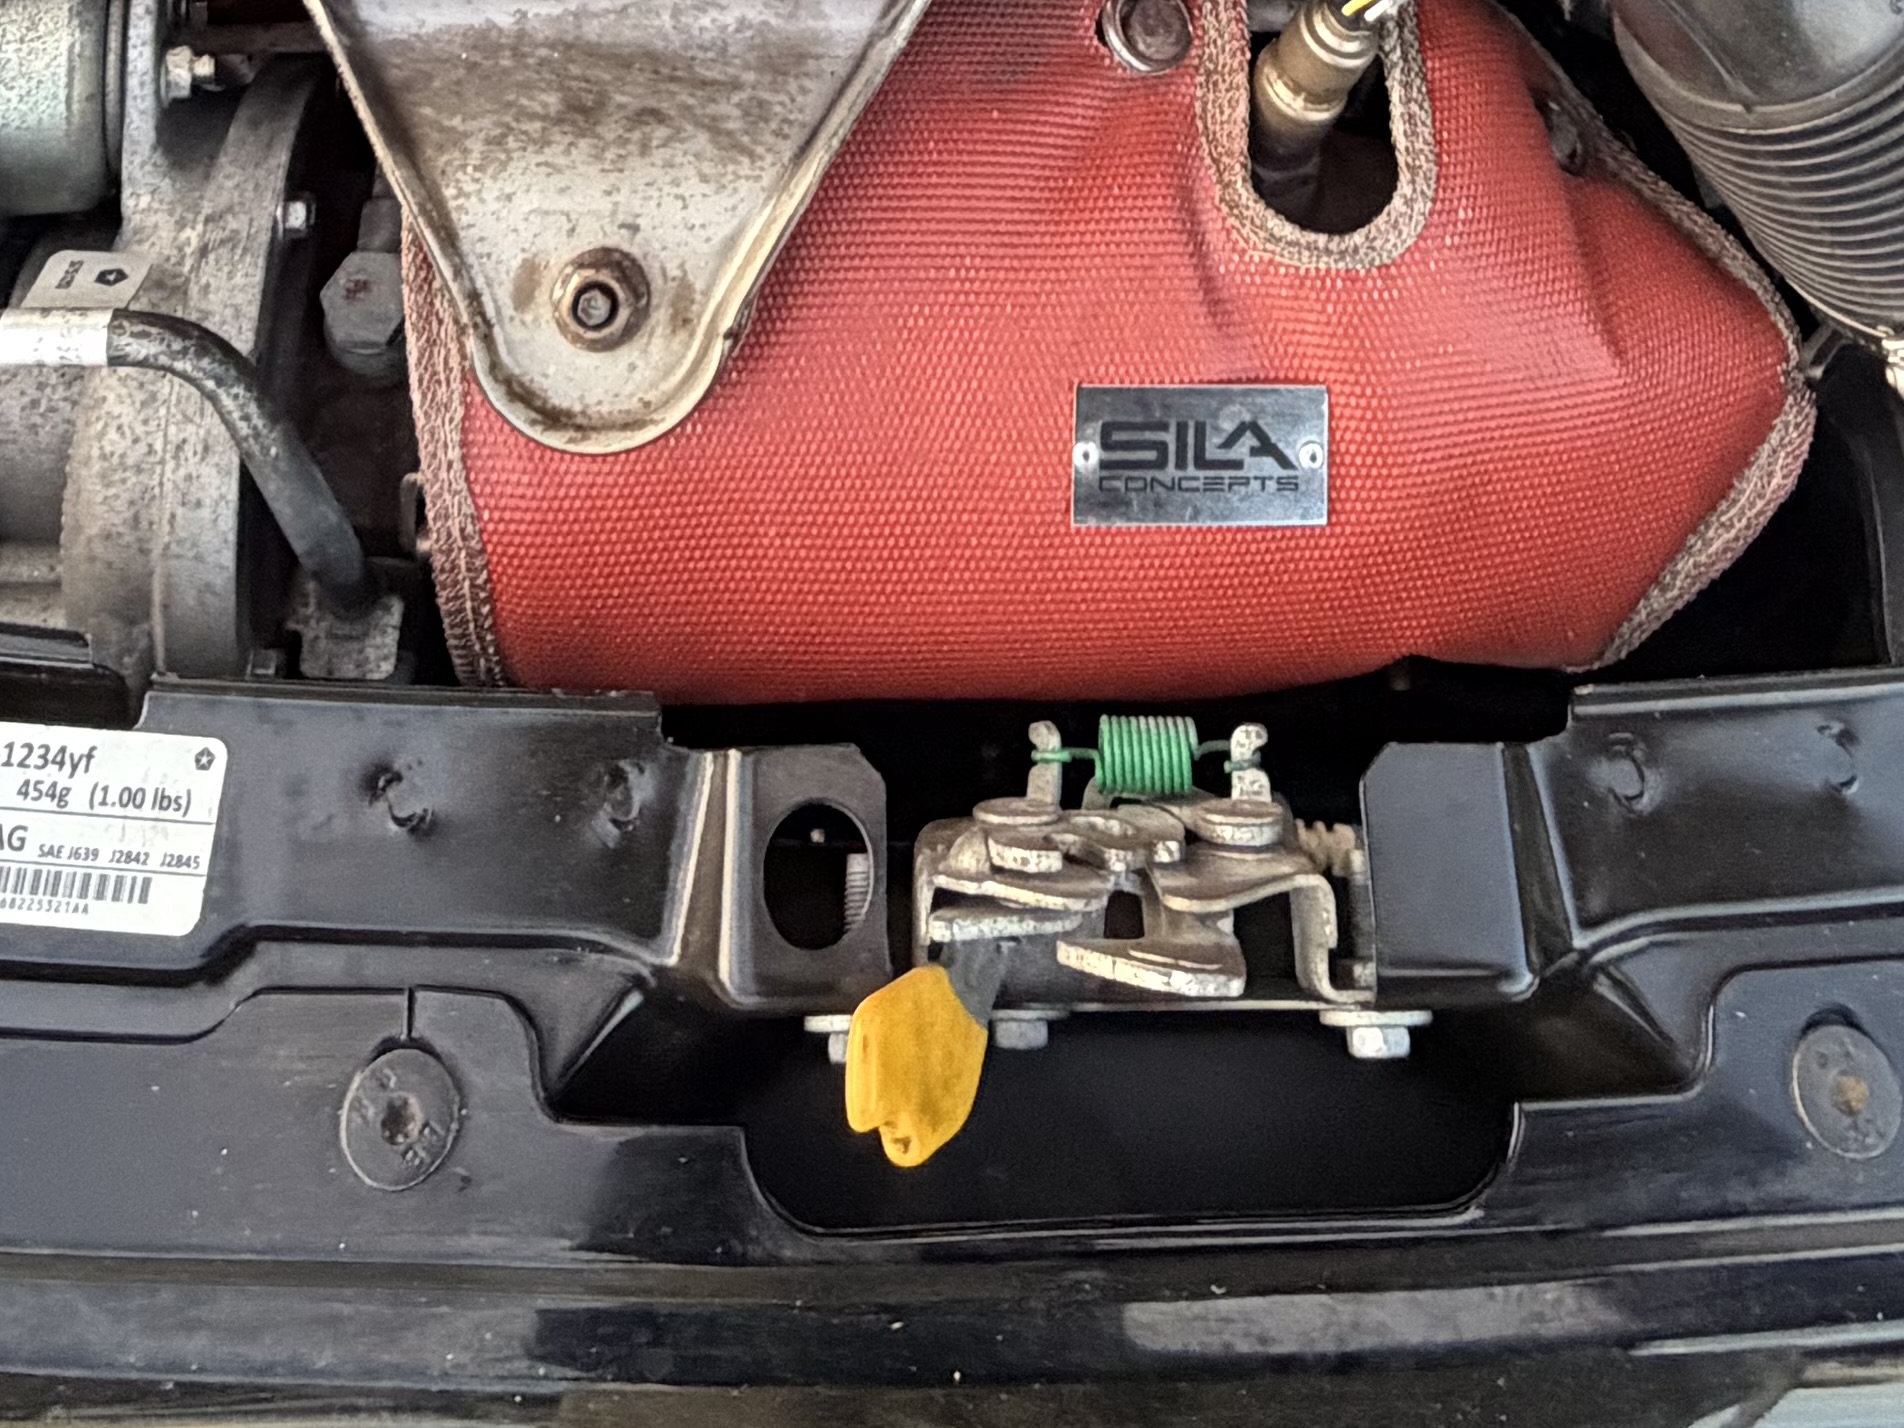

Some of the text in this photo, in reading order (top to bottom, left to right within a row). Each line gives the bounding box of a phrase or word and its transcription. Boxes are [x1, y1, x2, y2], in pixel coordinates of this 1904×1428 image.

[1099, 420, 1299, 471] SILA
[1099, 475, 1299, 492] CONCEPTS
[16, 778, 193, 818] 454g (1.00 lbs)
[37, 843, 201, 870] SAE J639 J2842 J2845
